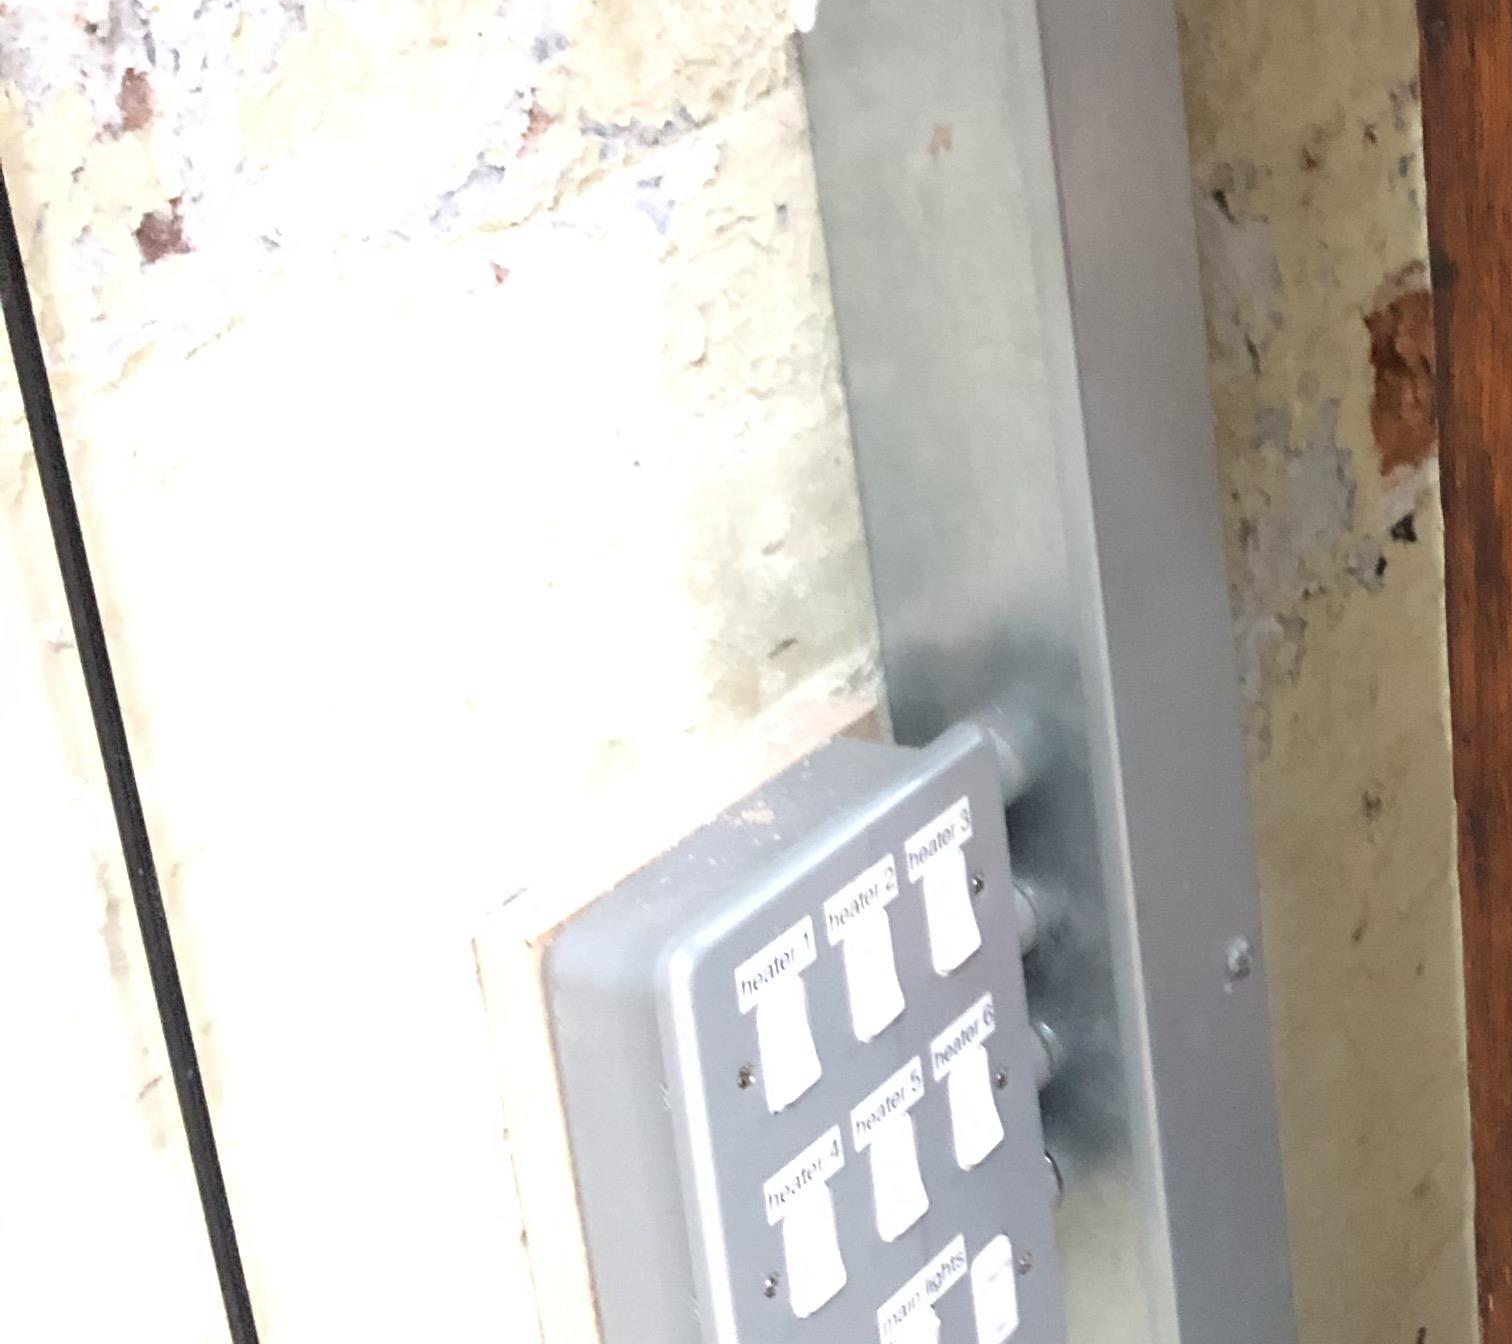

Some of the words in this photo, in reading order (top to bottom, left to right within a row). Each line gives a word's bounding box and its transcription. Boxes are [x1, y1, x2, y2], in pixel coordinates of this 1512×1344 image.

[908, 827, 956, 870] heater
[828, 883, 881, 930] heater
[741, 947, 796, 996] heater
[933, 1021, 980, 1068] heater
[855, 1093, 908, 1134] heater
[768, 1160, 823, 1210] heater
[882, 1292, 922, 1330] main
[925, 1250, 966, 1292] lights
